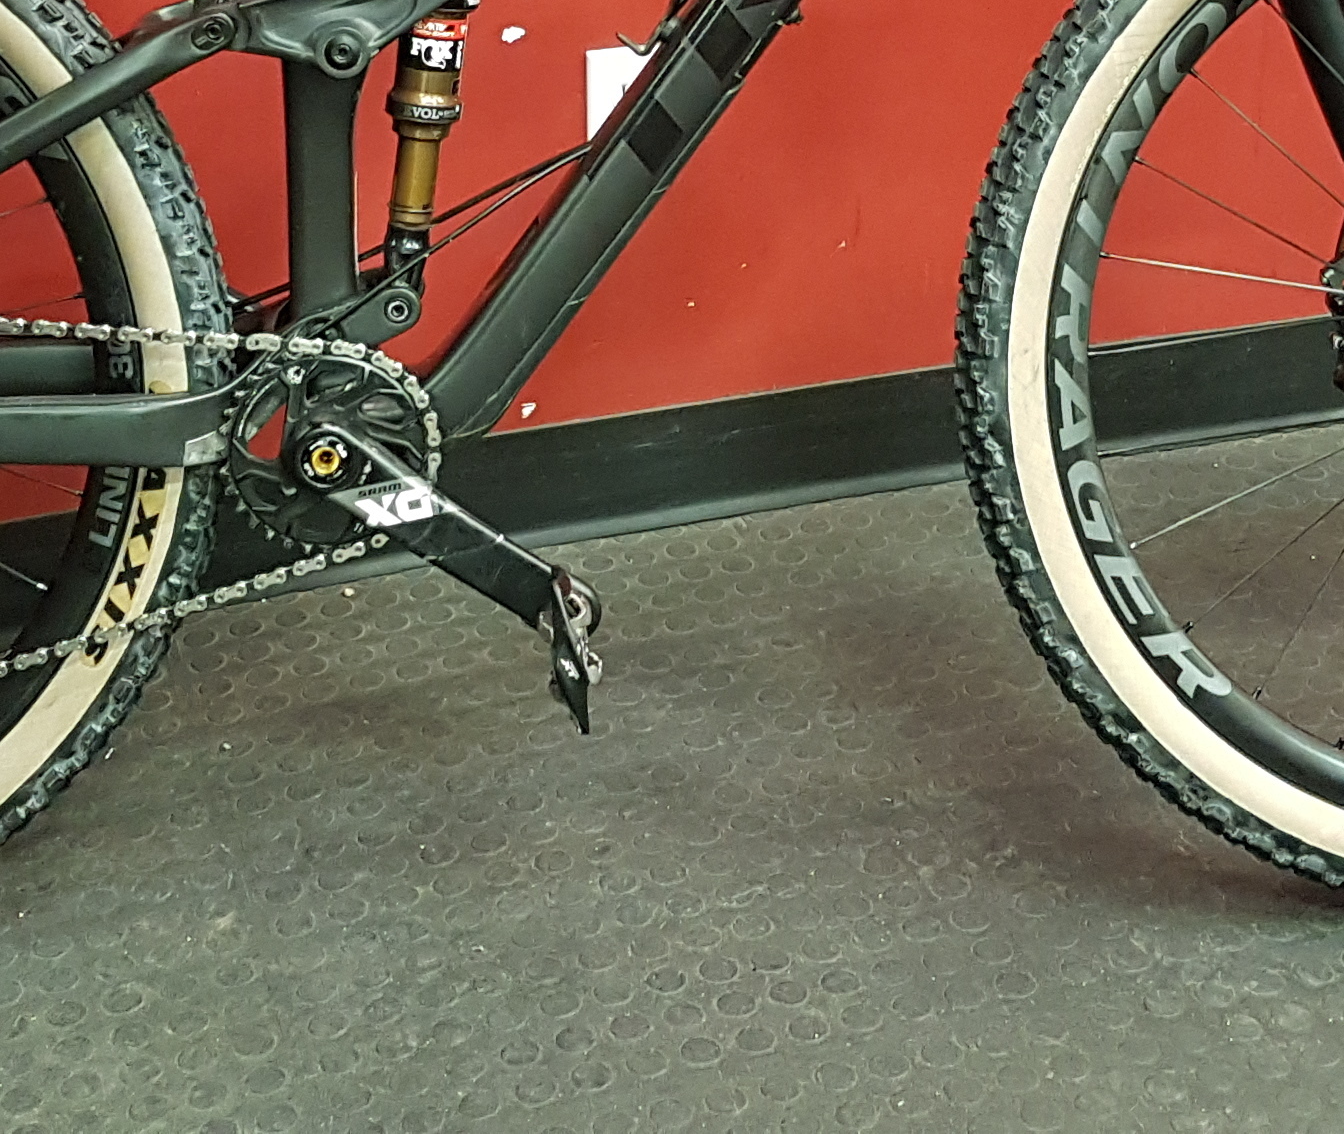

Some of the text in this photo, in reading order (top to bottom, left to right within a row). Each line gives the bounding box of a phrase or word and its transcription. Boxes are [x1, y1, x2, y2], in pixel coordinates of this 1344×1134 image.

[411, 37, 454, 70] FOX
[358, 482, 402, 498] SRAM
[88, 467, 132, 549] LIN
